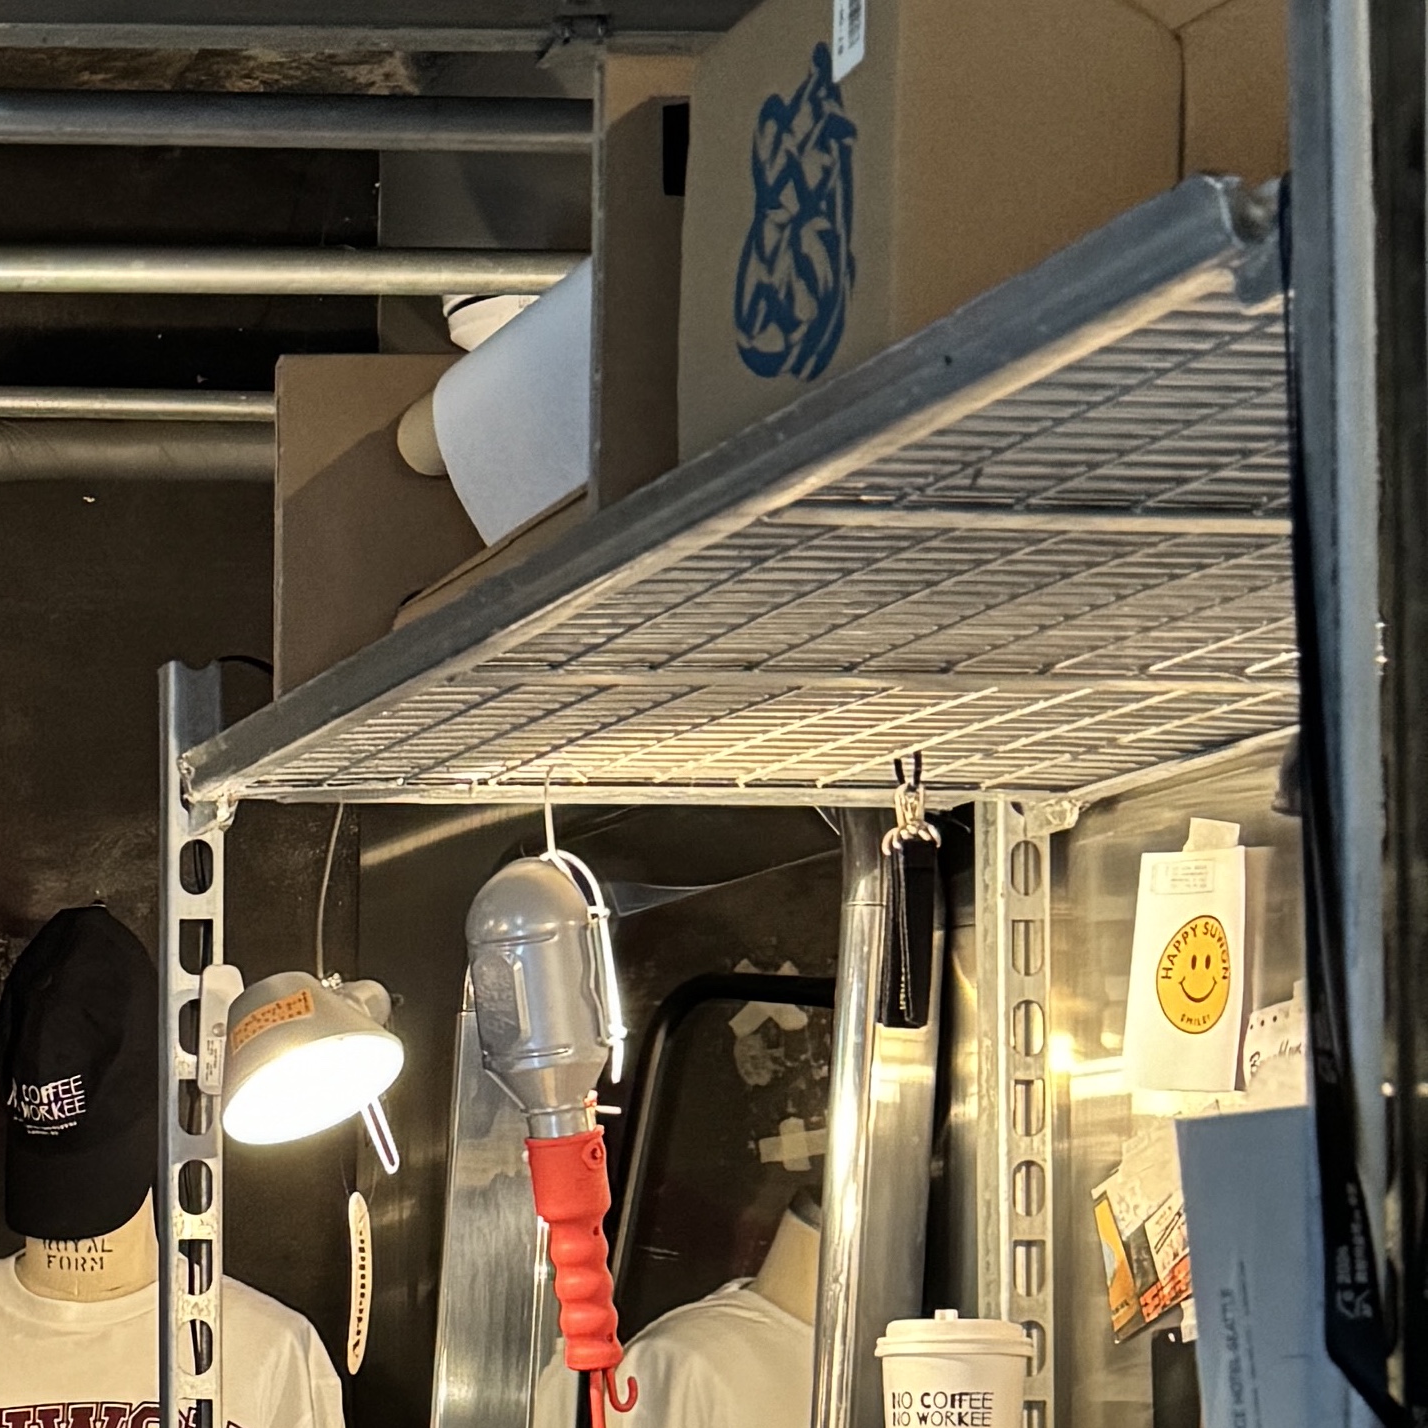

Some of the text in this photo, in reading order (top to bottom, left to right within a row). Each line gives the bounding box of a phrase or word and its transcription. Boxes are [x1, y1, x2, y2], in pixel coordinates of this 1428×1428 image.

[1160, 920, 1229, 981] HAPPY SUWON
[22, 1074, 84, 1105] COFFEE
[47, 1255, 105, 1272] FORM
[892, 1391, 995, 1410] NO COFFEE
[892, 1410, 993, 1427] NO WORKEE
